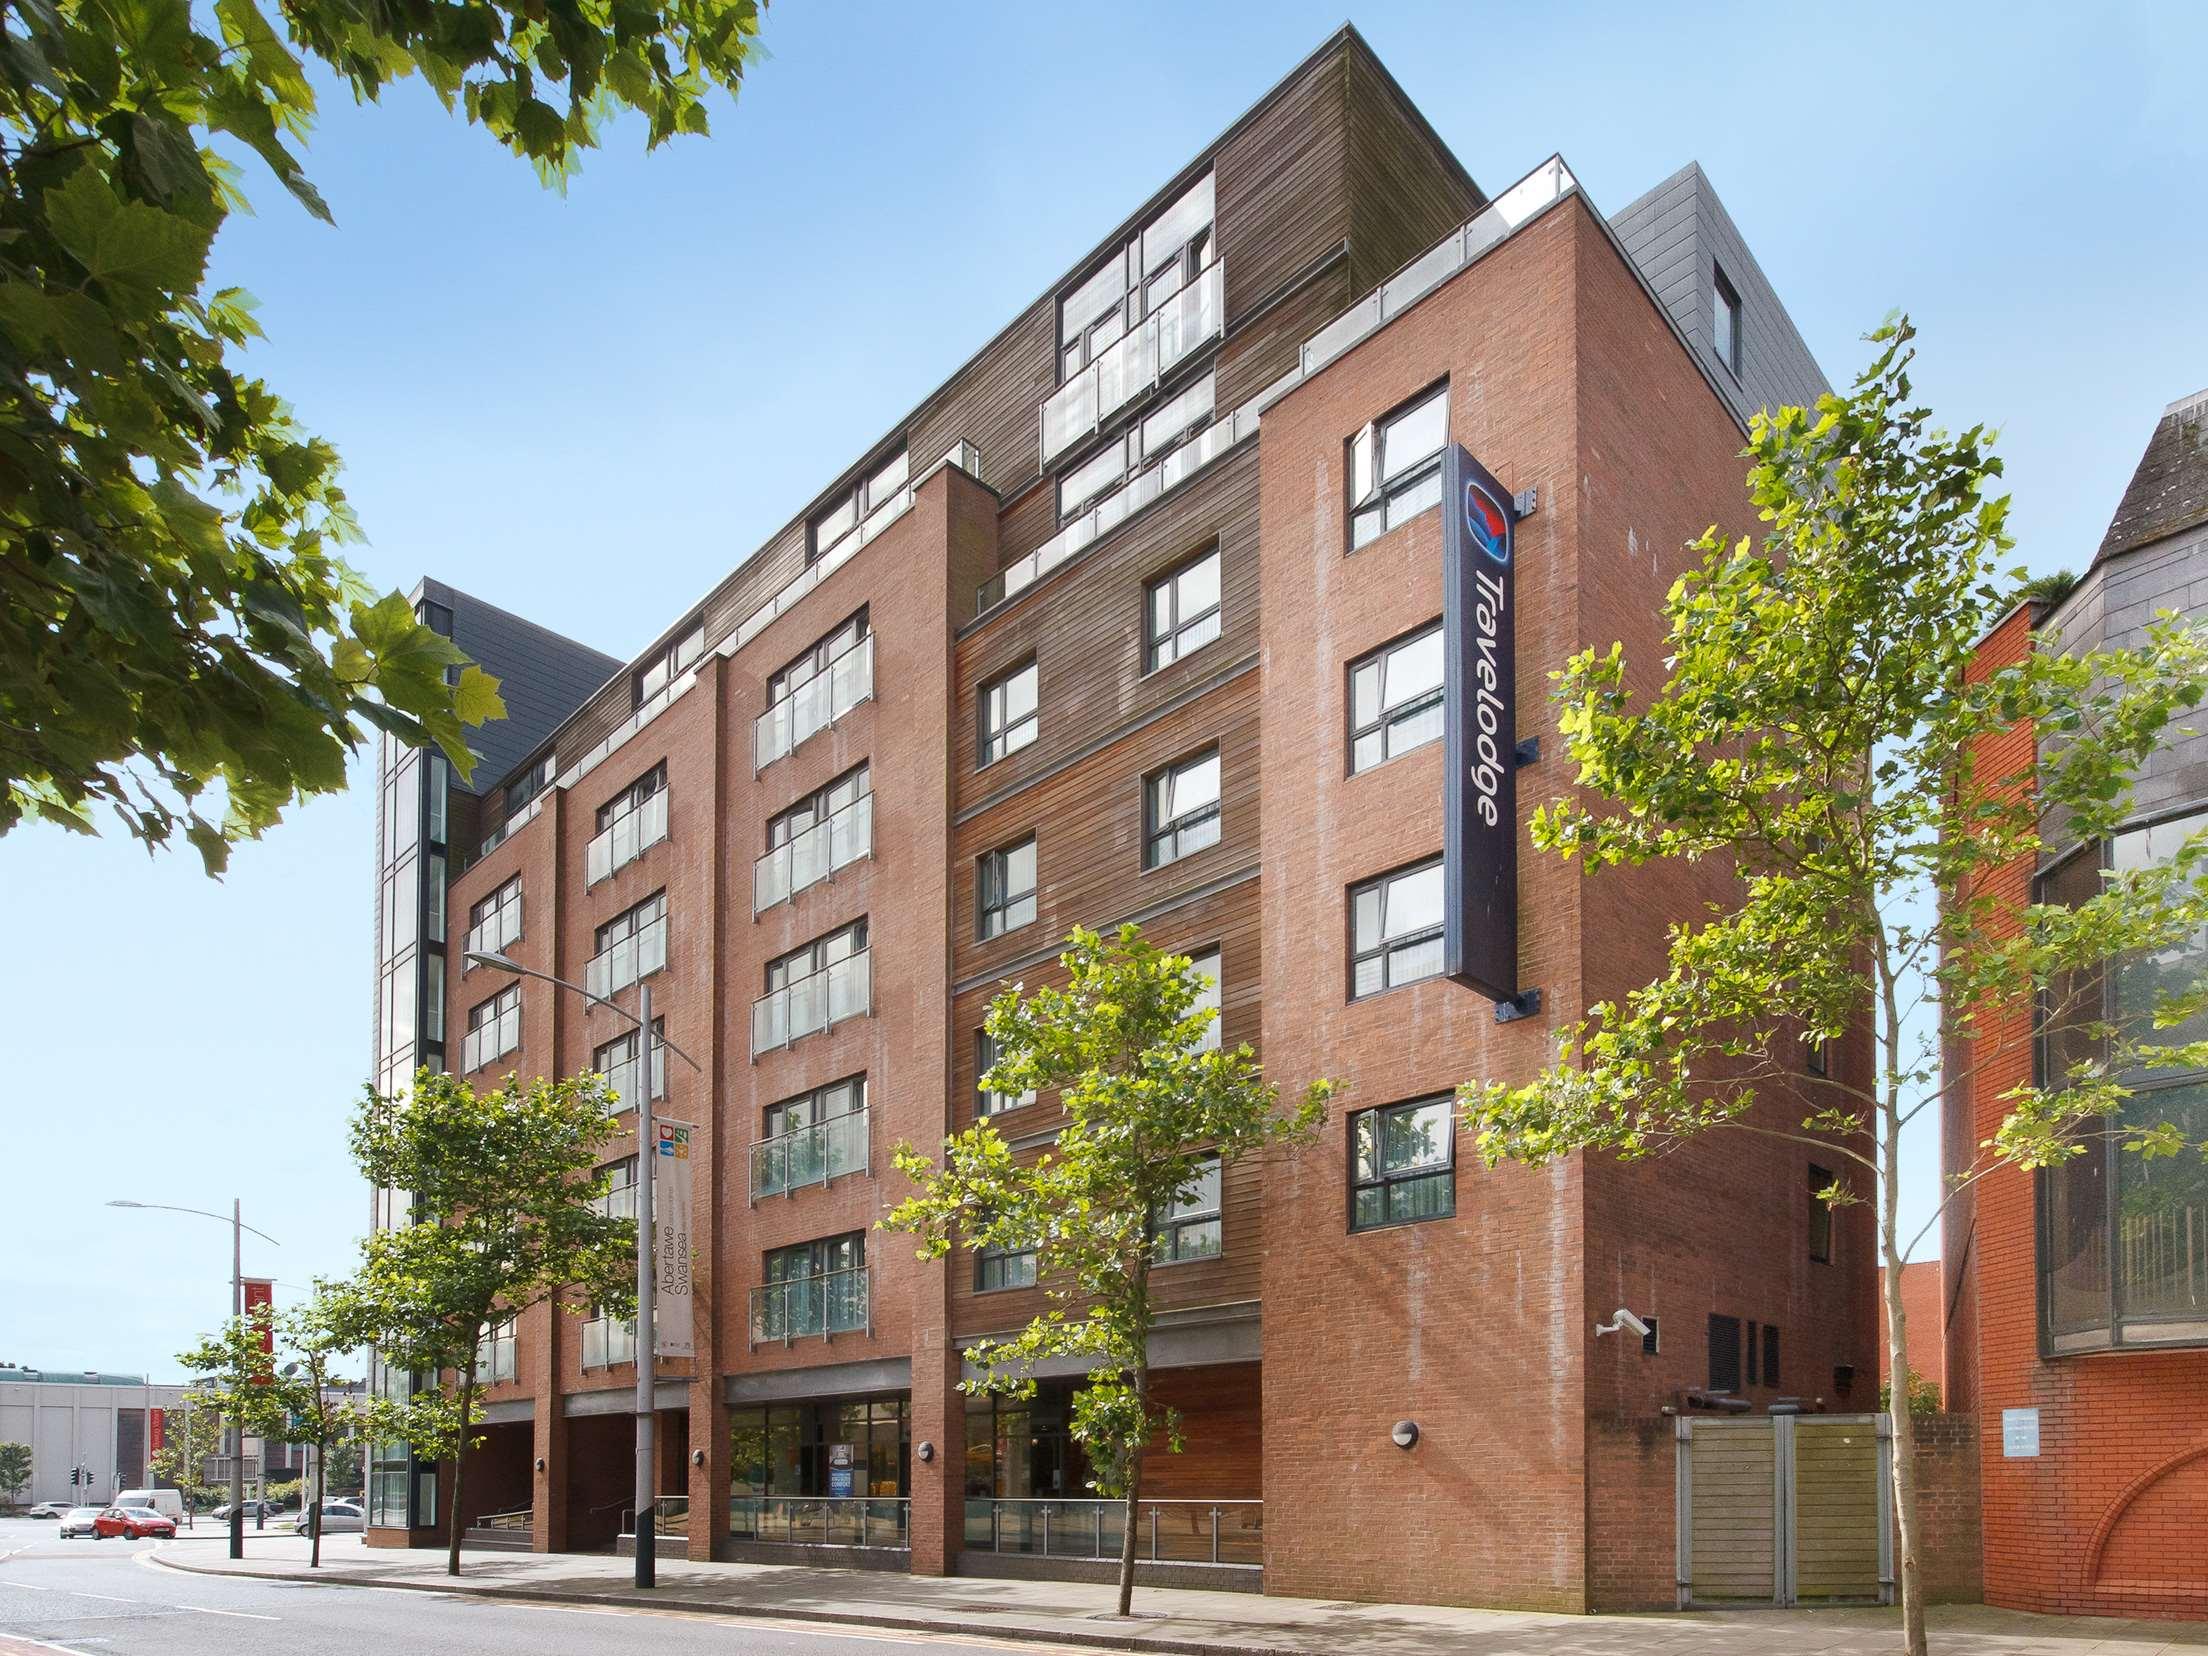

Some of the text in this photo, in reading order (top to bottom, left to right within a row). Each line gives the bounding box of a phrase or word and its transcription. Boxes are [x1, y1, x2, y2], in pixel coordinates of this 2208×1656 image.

[1471, 569, 1505, 827] Travelodge
[661, 1225, 674, 1296] Abertawe
[675, 1232, 689, 1296] Swansea
